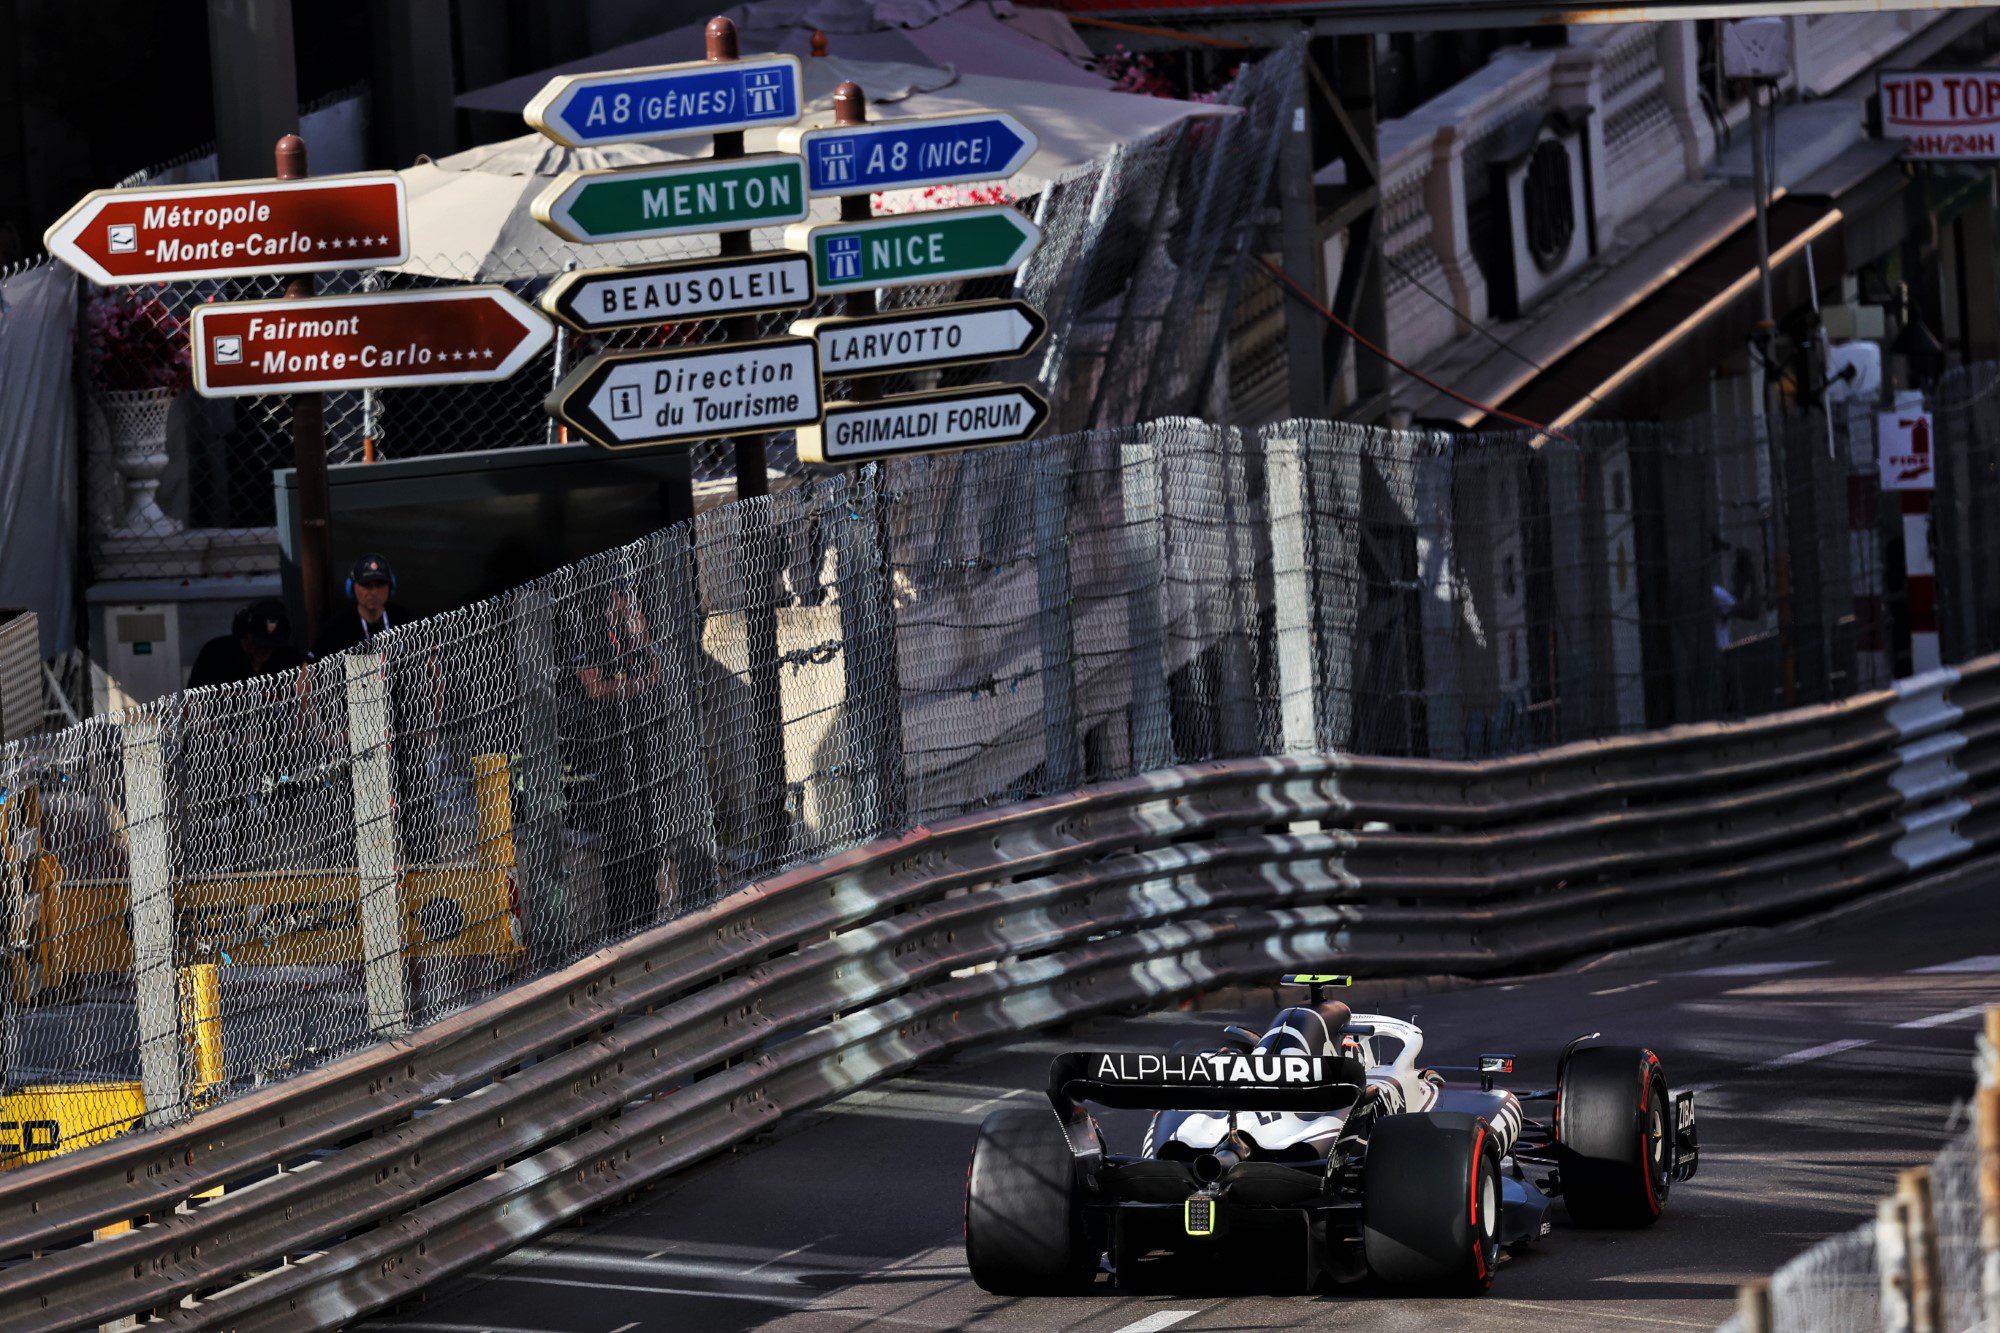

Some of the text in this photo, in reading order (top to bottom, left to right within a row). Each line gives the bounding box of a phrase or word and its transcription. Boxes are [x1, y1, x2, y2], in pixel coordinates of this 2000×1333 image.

[586, 87, 736, 127] A8 (GÊNES)
[1883, 77, 2000, 118] TIP TOP
[866, 136, 991, 175] A8 (NICE)
[143, 200, 271, 231] Métropole
[642, 175, 791, 220] MENTON
[871, 233, 945, 270] NICE
[602, 270, 795, 314] BEAUSOLEIL
[248, 315, 360, 342] Fairmont
[830, 325, 962, 363] LARVOTTO
[654, 360, 794, 396] Direction
[656, 393, 800, 428] du Tourisme
[836, 402, 1021, 447] GRIMALDI FORUM
[1097, 1053, 1322, 1083] ALPHATAURI
[1679, 1098, 1695, 1130] ZIBA
